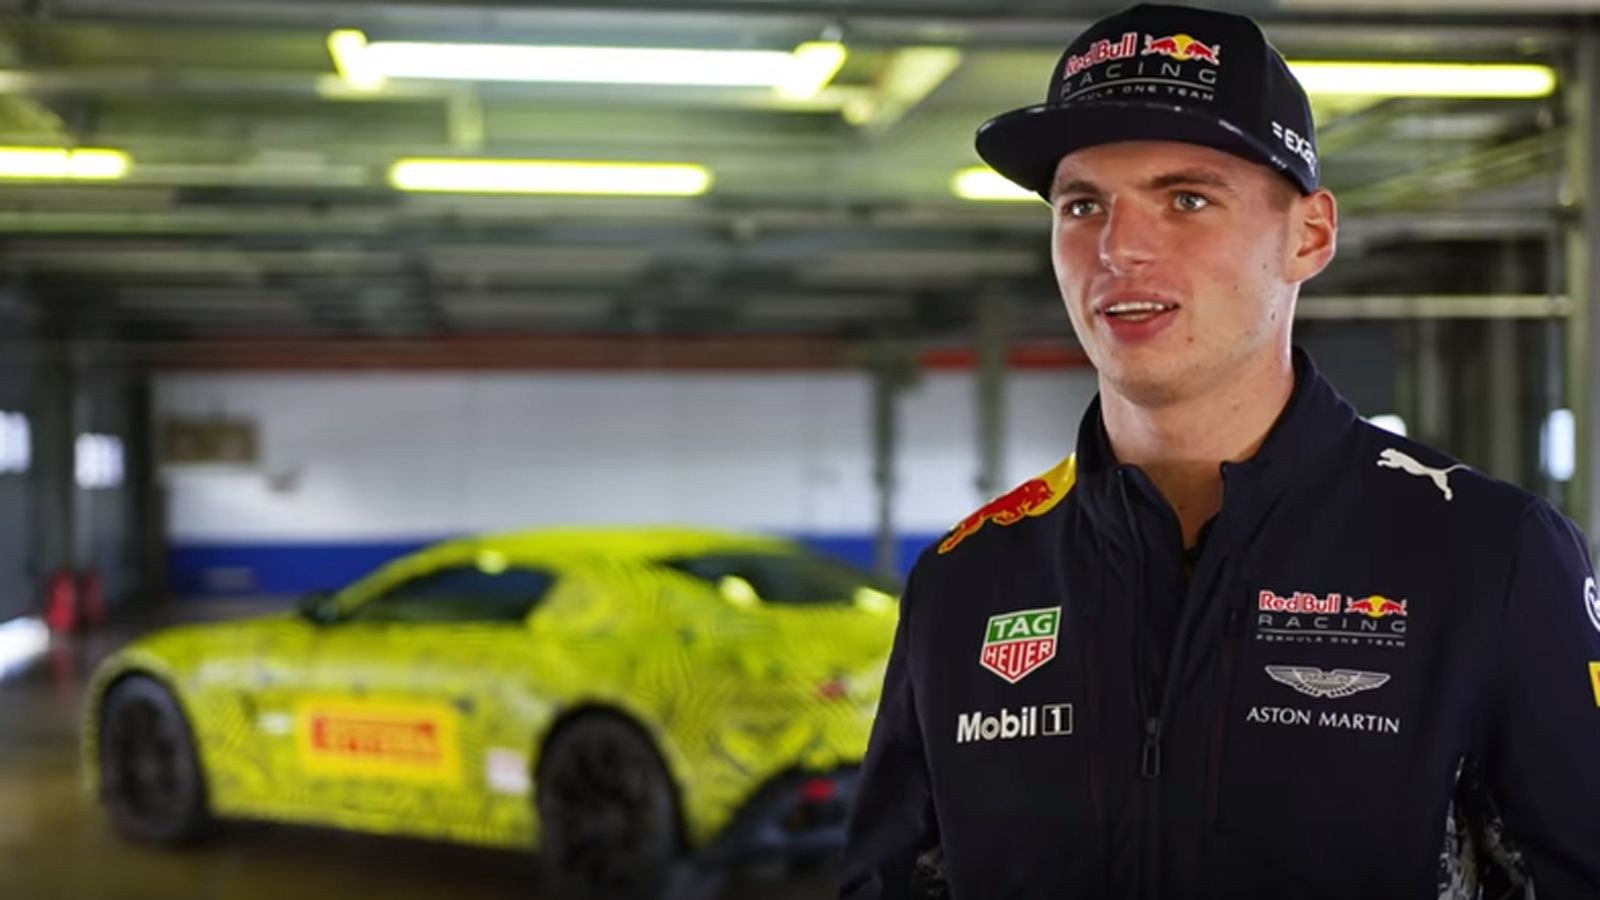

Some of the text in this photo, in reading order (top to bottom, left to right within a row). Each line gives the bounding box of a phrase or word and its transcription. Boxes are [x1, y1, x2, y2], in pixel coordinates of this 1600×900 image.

[1061, 61, 1218, 97] RACING
[1122, 85, 1157, 94] ONE
[1167, 87, 1214, 101] TEAM
[993, 613, 1054, 640] TAG
[1257, 613, 1407, 633] RACING
[1256, 634, 1406, 647] FORMULA ONE TEAM
[984, 640, 1052, 677] HEUER
[956, 706, 1038, 744] Mobil
[1246, 706, 1401, 734] ASTON MARTIN
